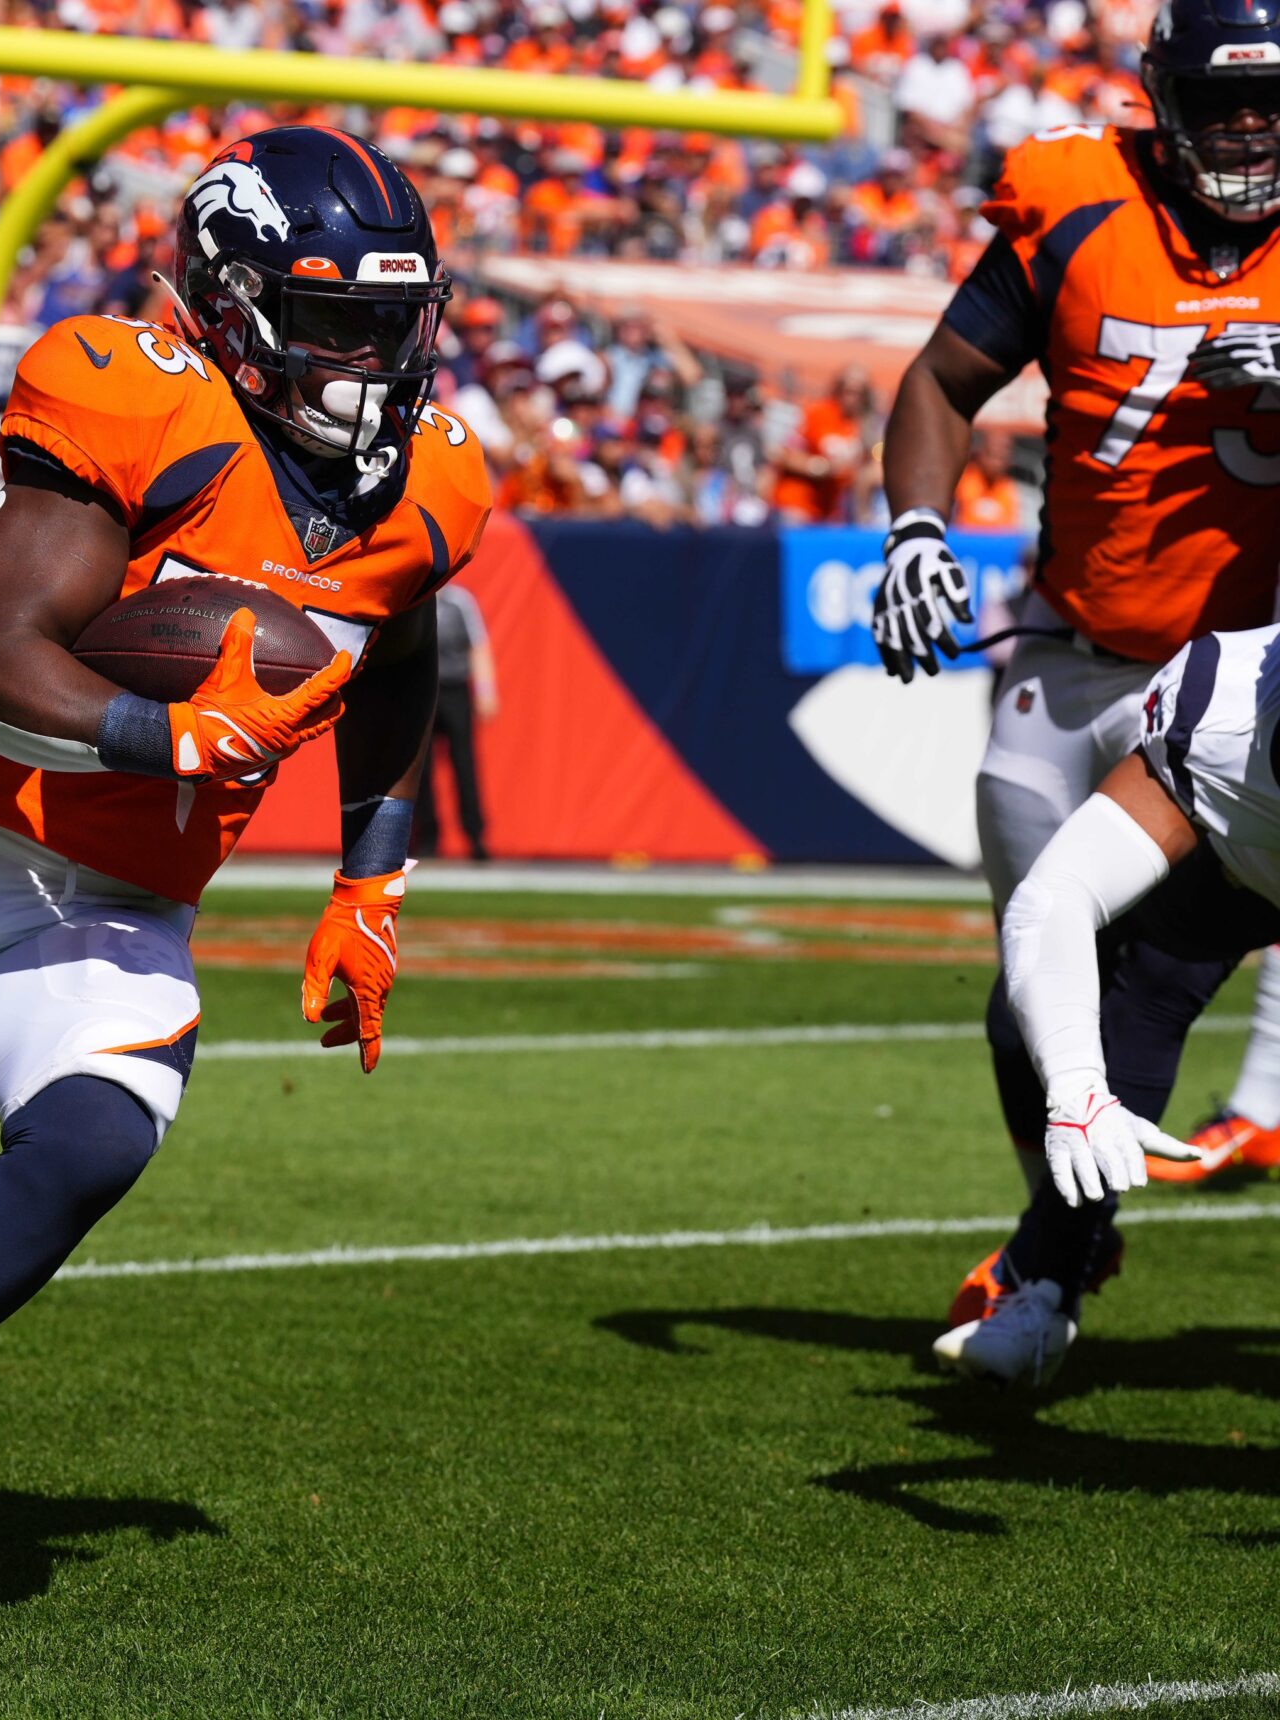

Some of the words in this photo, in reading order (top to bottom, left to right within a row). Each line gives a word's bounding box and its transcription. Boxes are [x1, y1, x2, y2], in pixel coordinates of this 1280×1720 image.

[379, 258, 417, 273] BRONCOS
[1174, 297, 1261, 313] BRONCOS
[261, 559, 343, 592] BRONCOS
[109, 607, 156, 624] NATIONAL
[159, 606, 216, 620] FOOTBALL
[150, 622, 202, 641] Wilson
